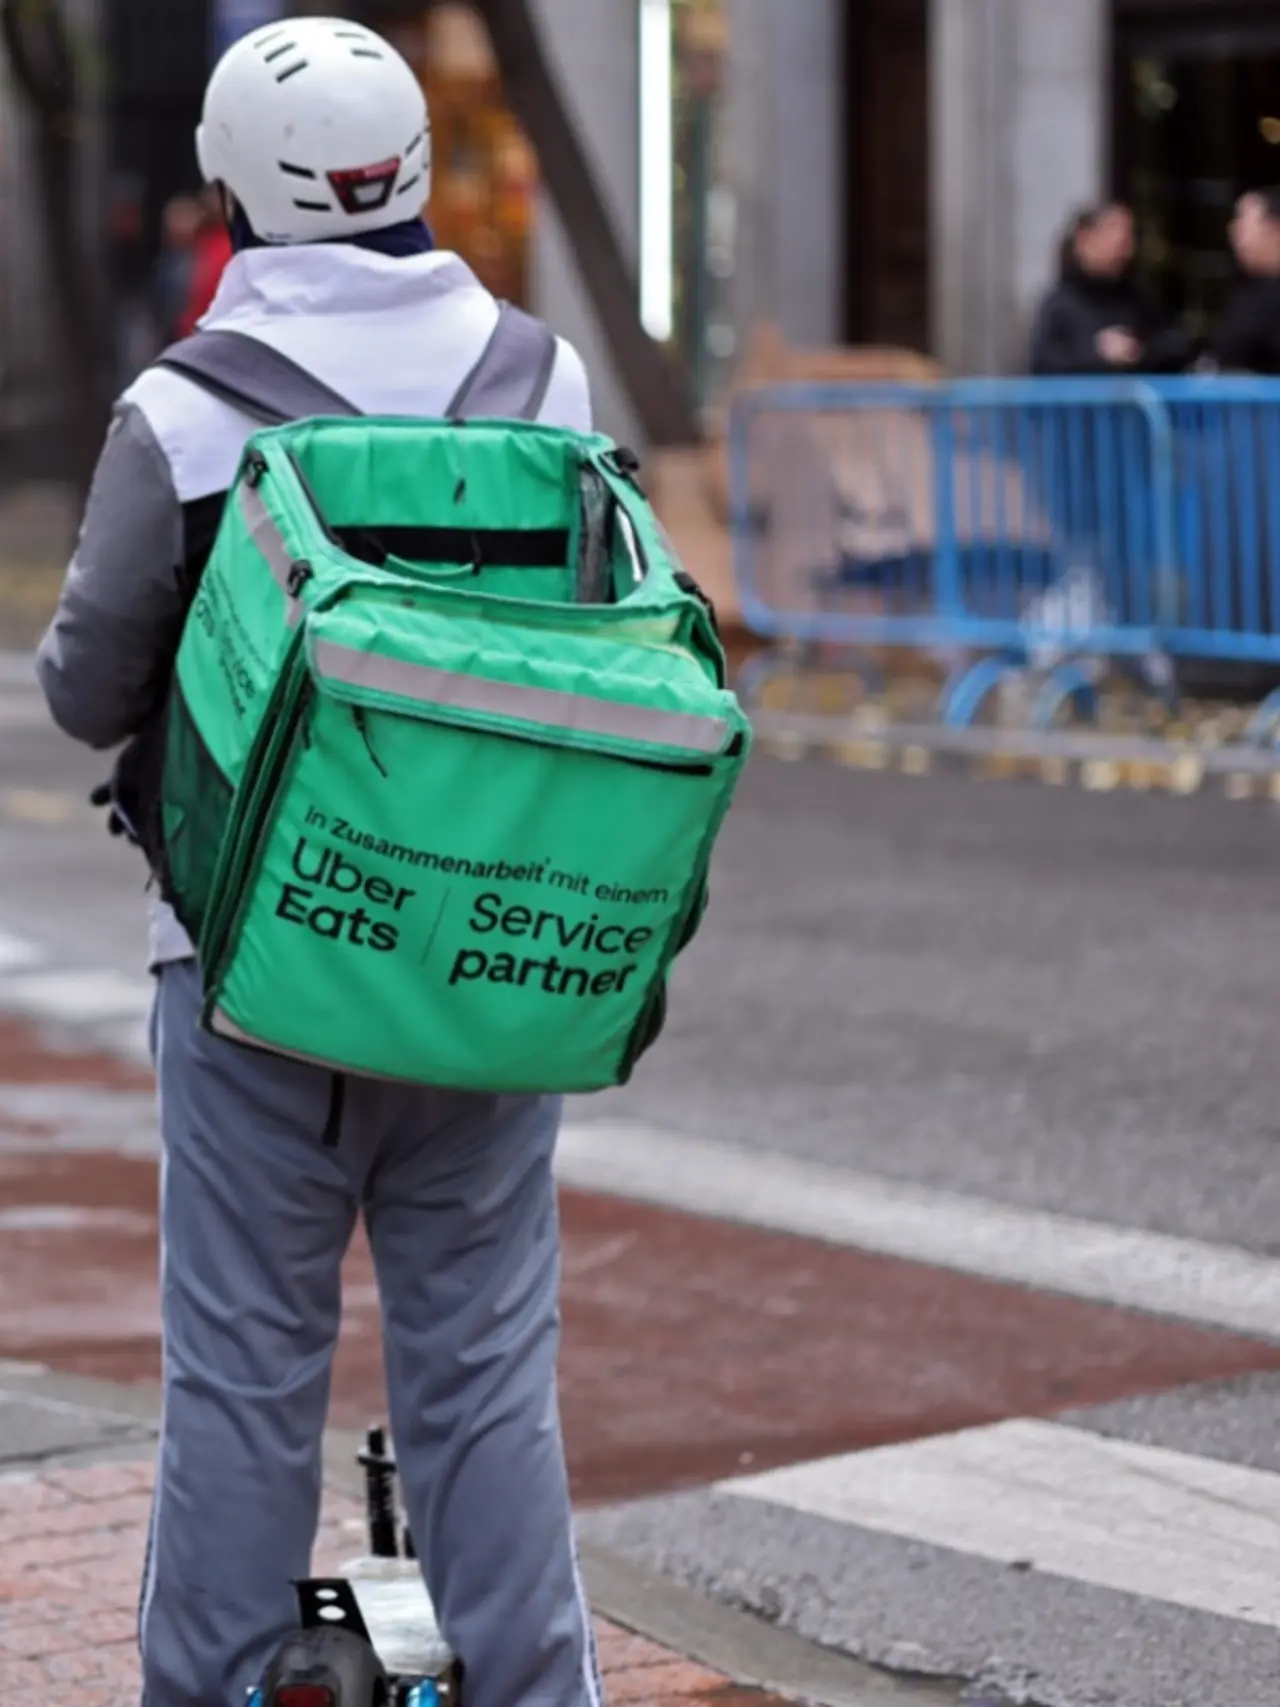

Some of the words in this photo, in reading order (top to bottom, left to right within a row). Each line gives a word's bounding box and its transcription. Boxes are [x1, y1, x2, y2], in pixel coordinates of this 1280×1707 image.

[291, 837, 416, 912] Uber
[330, 817, 546, 885] Zusammenarbeit
[548, 867, 590, 895] mit
[595, 882, 669, 905] einem
[275, 882, 400, 952] Eats
[468, 892, 653, 955] Service
[448, 947, 638, 997] partner
